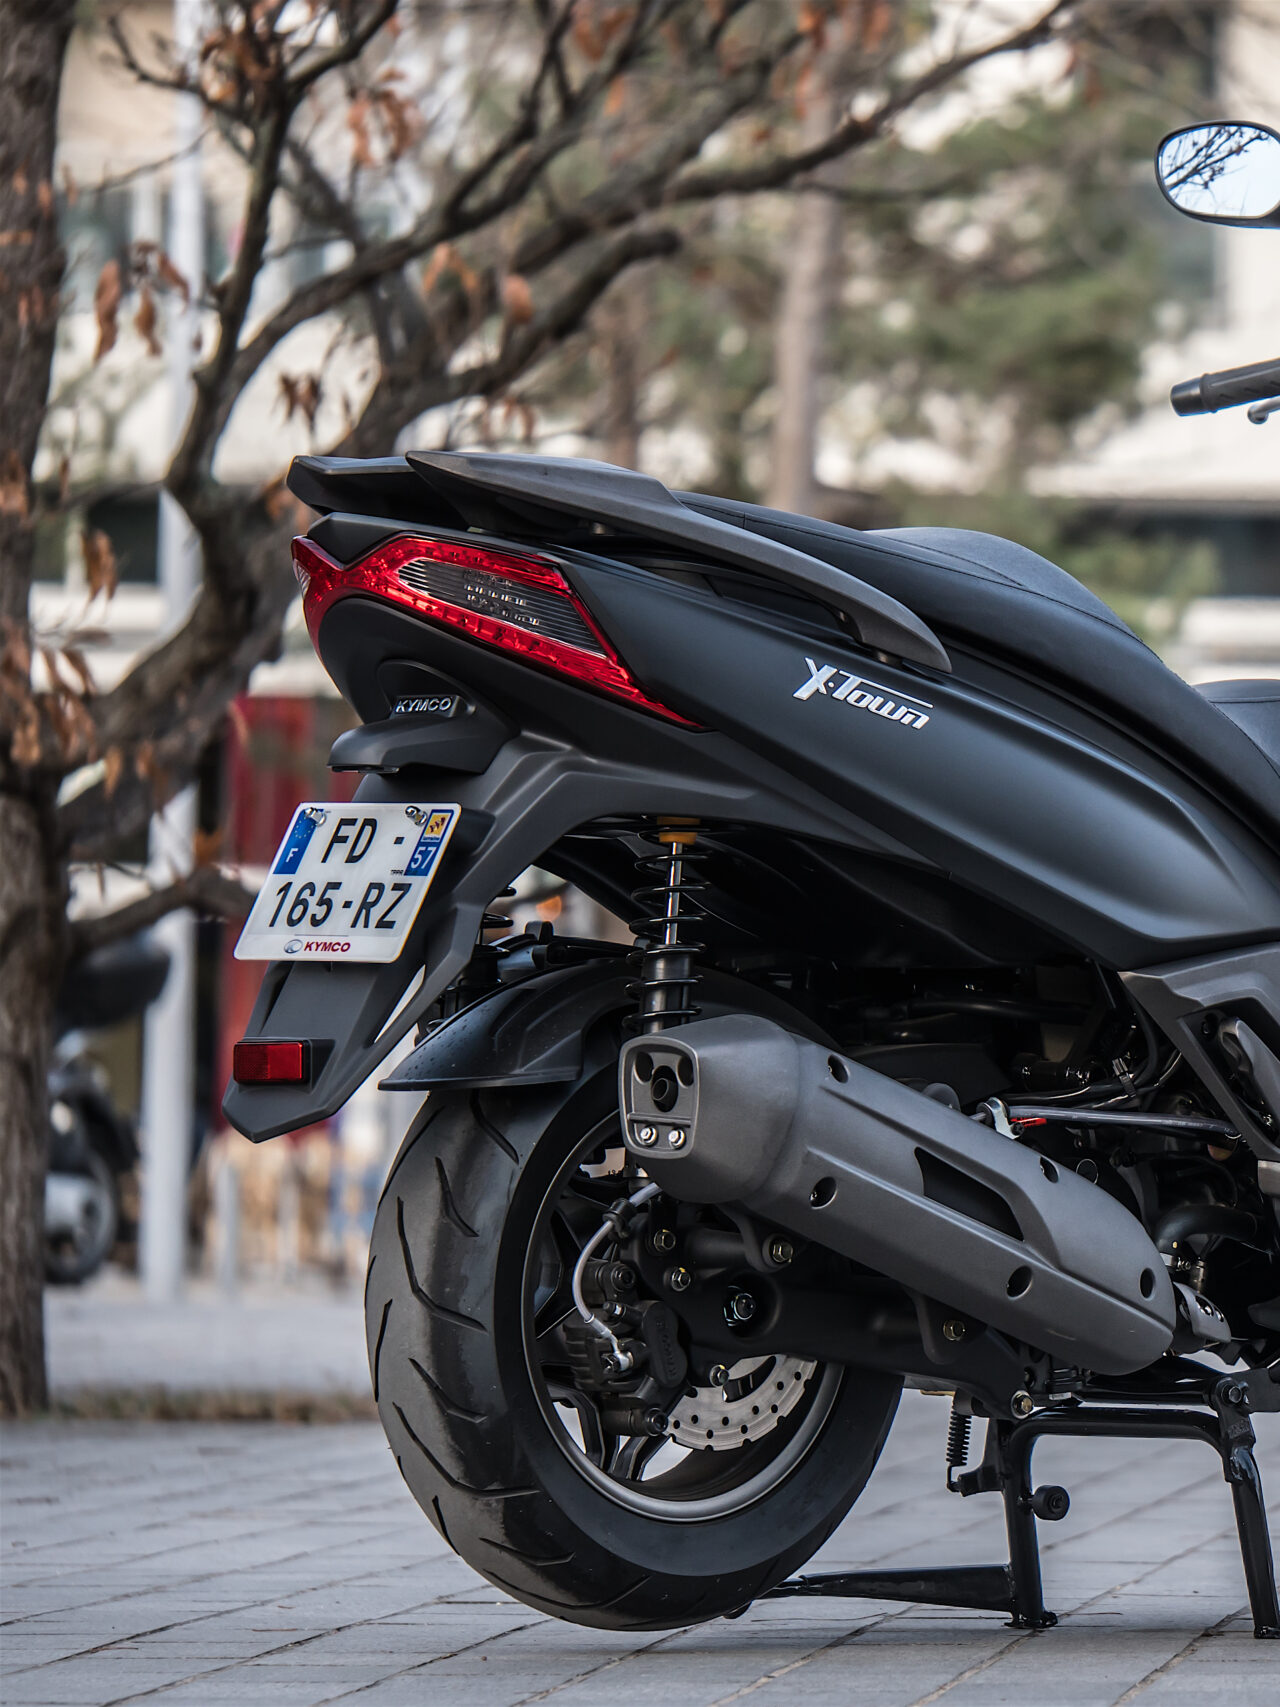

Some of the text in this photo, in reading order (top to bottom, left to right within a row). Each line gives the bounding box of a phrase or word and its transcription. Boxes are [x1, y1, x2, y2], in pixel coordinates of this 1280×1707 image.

[395, 697, 453, 713] KYMCO
[320, 817, 378, 864] FD
[285, 847, 299, 863] F
[410, 846, 438, 869] 57
[268, 881, 413, 929] 165-RZ
[303, 941, 351, 953] KYMCO
